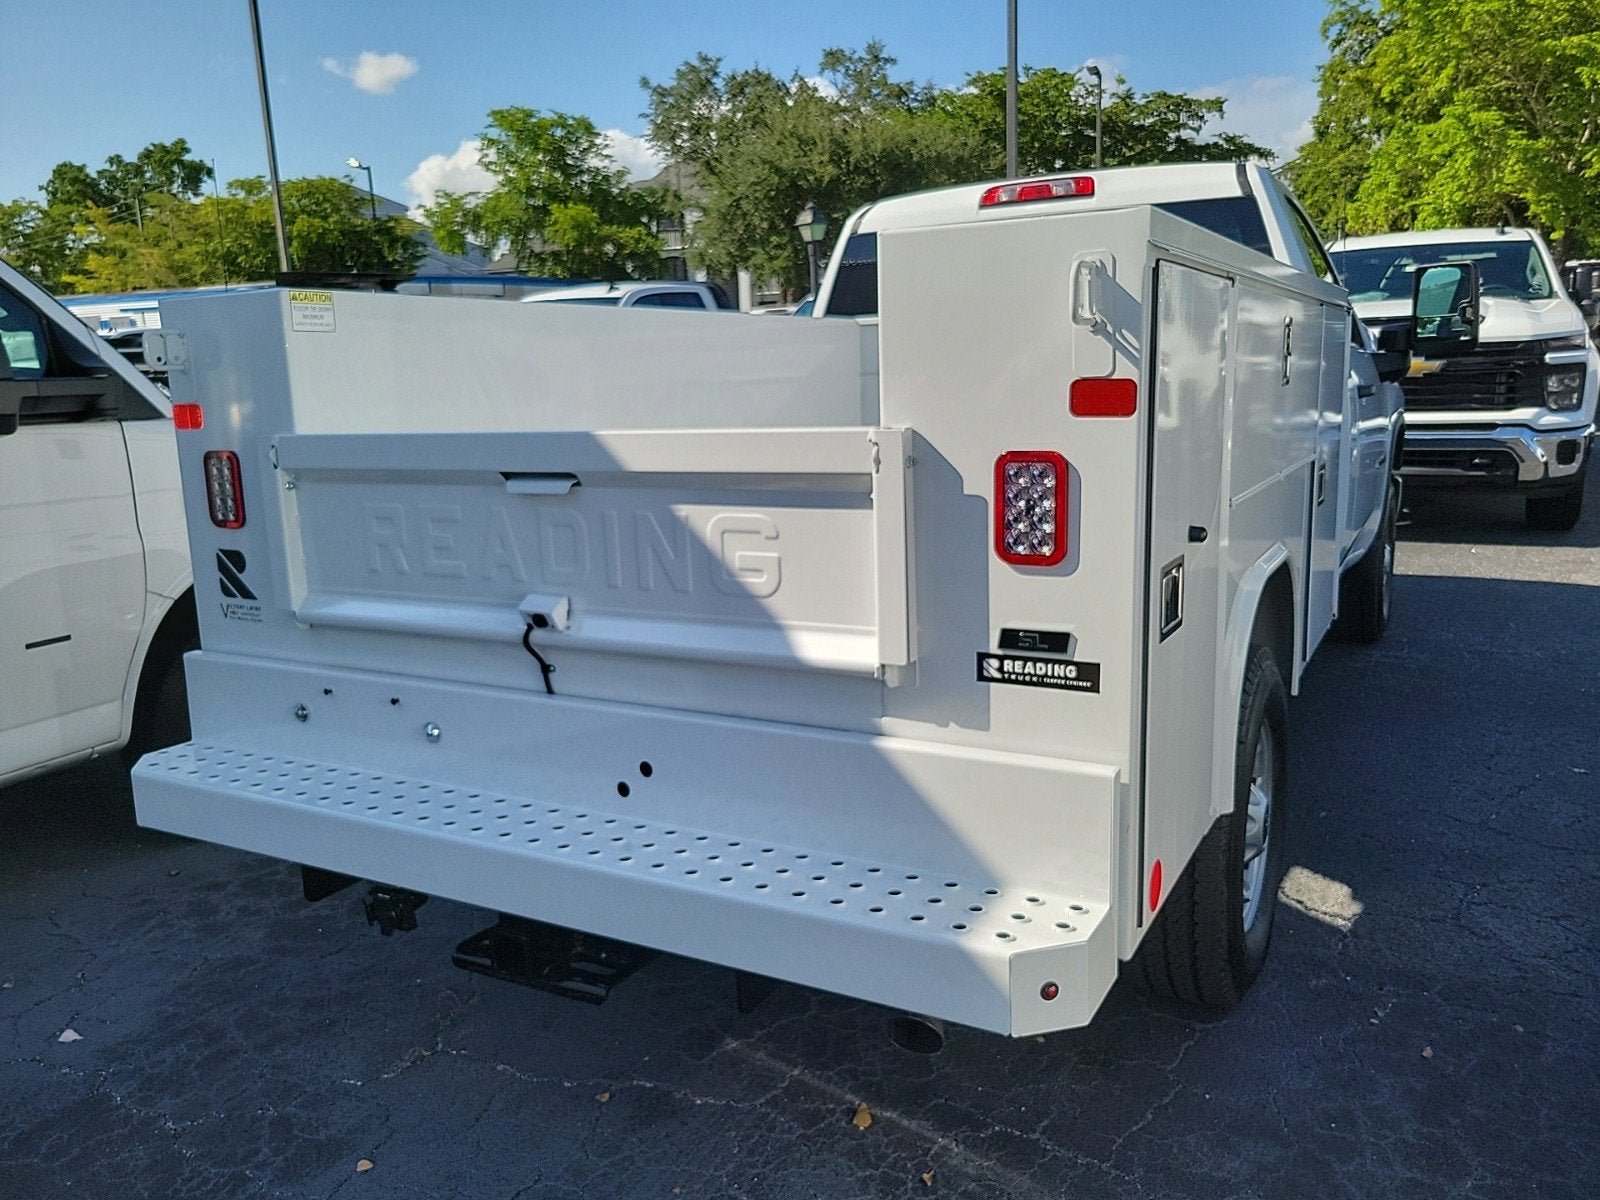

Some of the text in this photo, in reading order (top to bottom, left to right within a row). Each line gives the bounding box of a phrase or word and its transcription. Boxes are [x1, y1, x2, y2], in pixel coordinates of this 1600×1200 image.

[298, 293, 332, 303] CAUTION
[362, 501, 783, 599] READING
[1003, 659, 1078, 679] READING
[1003, 673, 1039, 683] TRUCK
